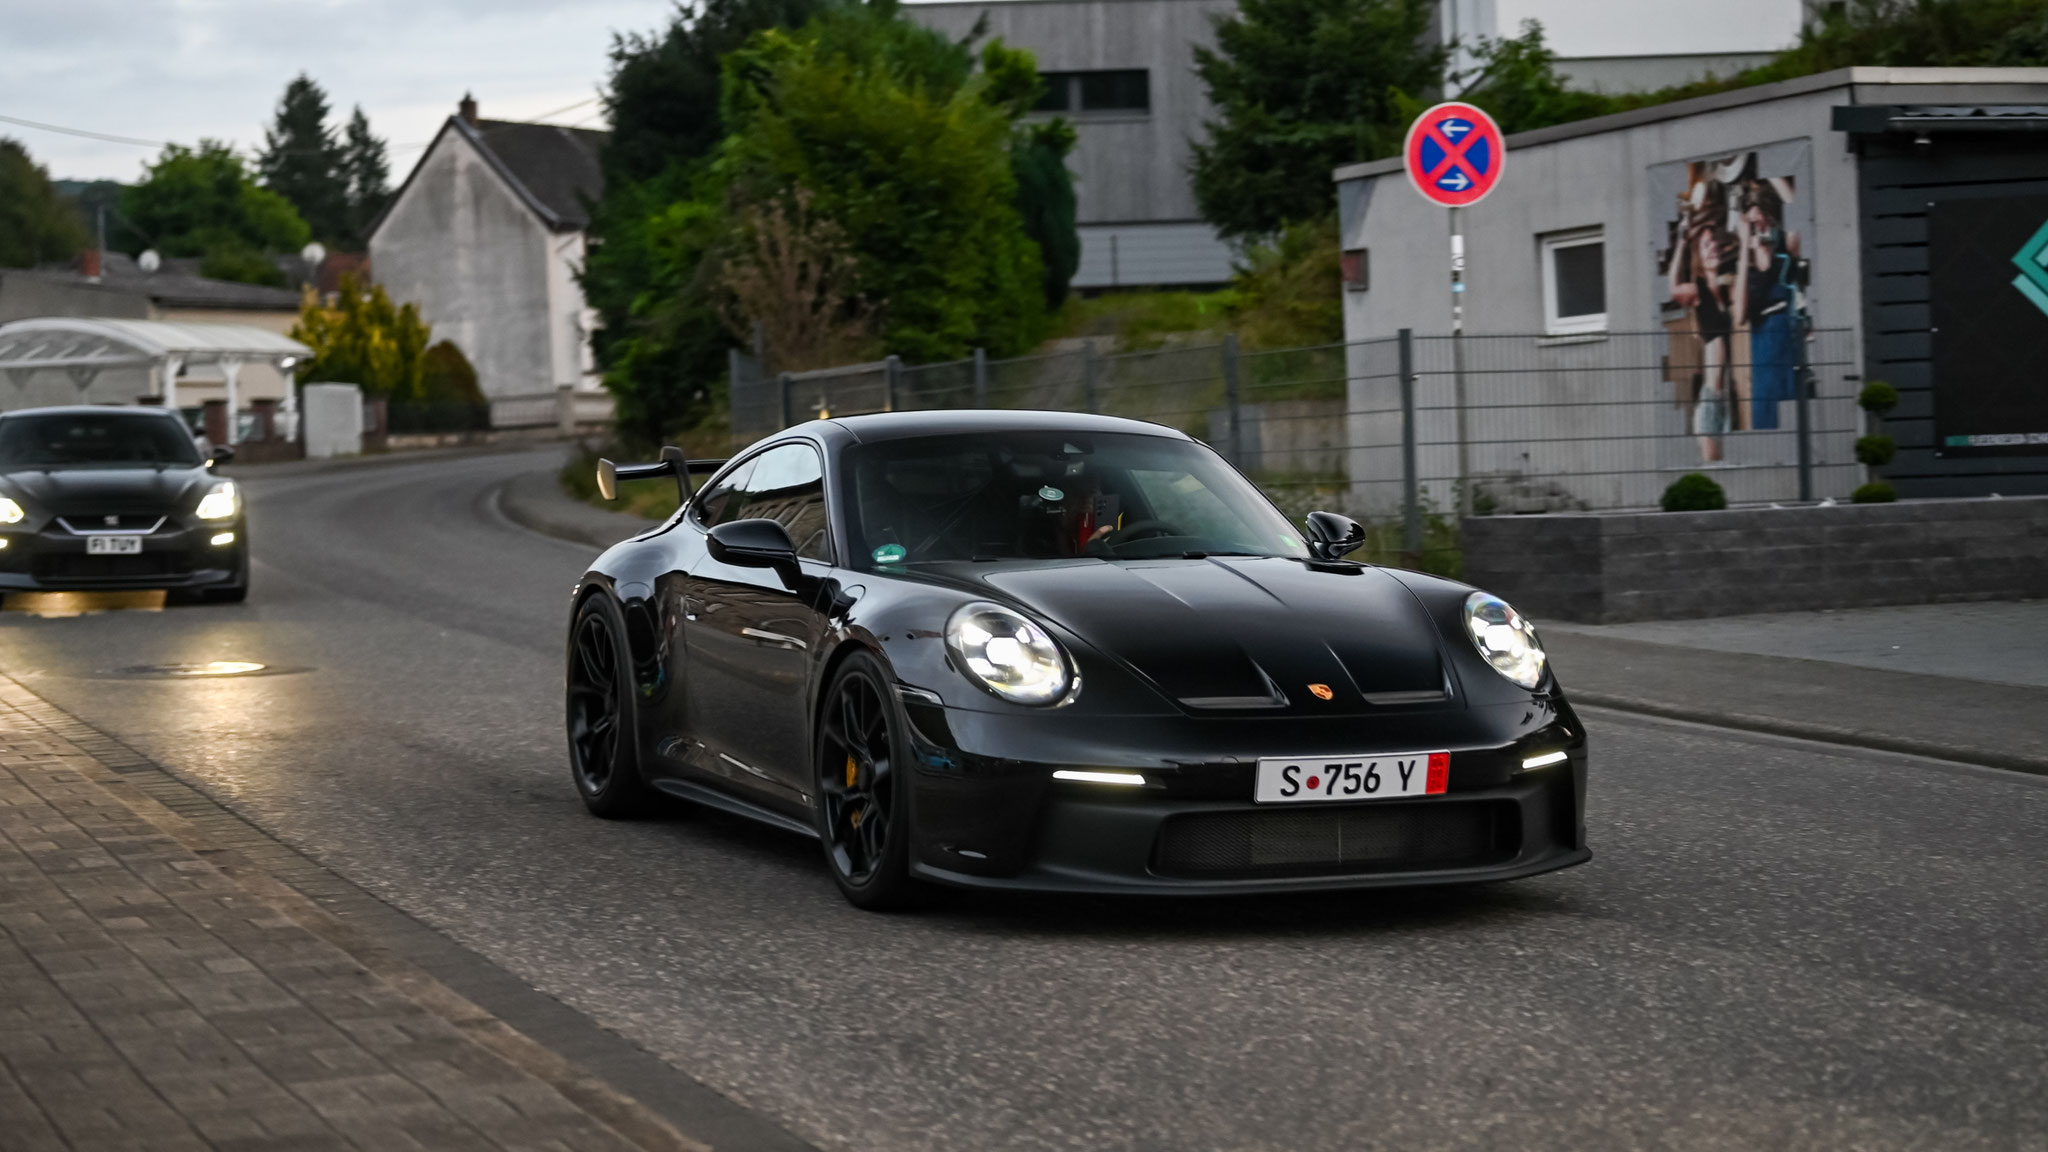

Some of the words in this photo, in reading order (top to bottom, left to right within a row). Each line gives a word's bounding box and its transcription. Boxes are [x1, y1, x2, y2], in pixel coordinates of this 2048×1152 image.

[1280, 765, 1301, 797] S
[1324, 762, 1381, 795] 756
[1398, 760, 1416, 791] Y
